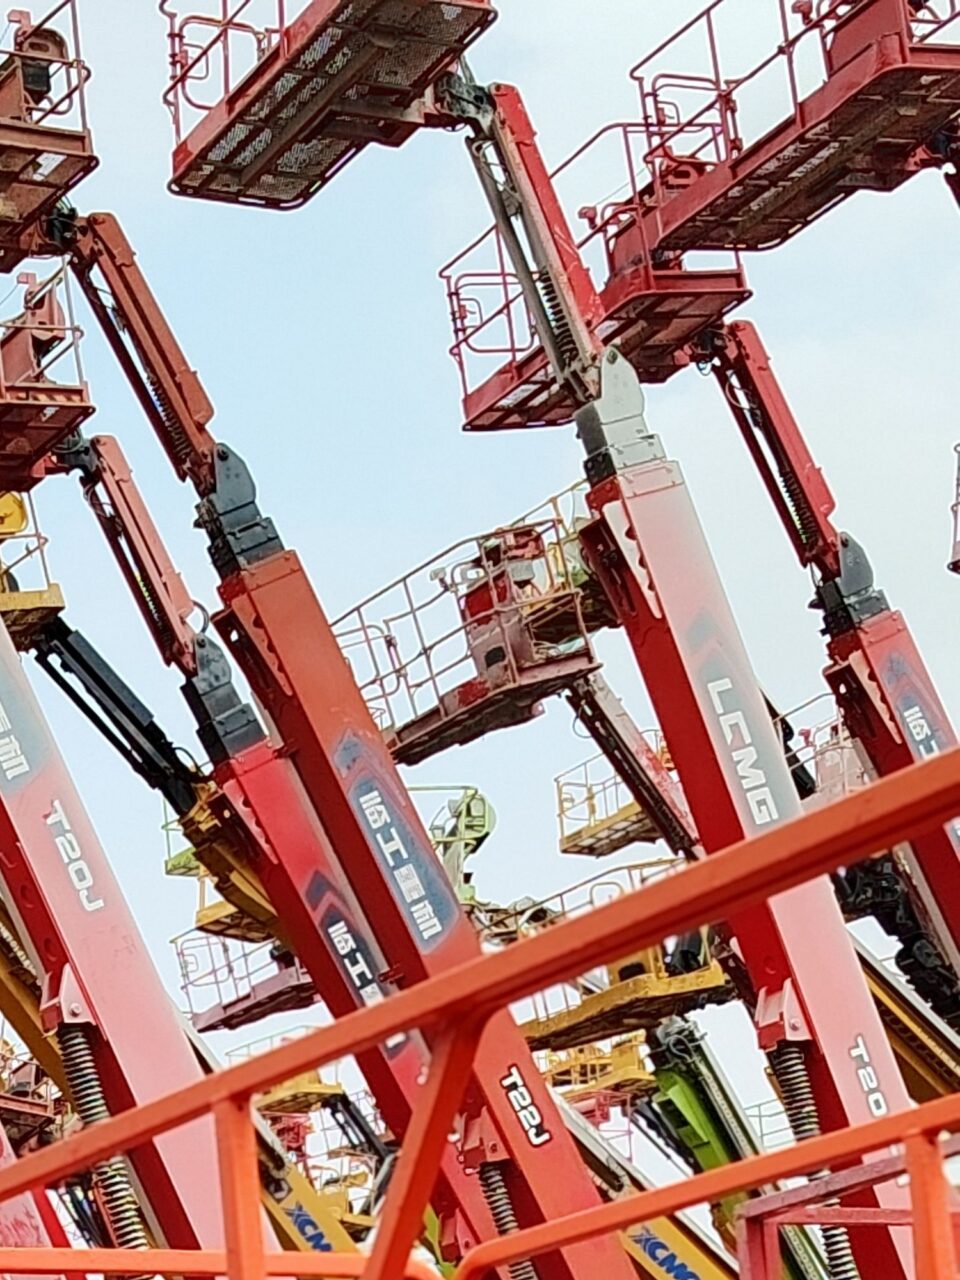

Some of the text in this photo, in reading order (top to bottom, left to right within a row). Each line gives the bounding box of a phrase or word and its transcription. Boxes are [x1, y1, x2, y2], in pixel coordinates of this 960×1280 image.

[46, 800, 104, 912] T20J
[360, 790, 443, 940] 临工重机
[500, 1065, 551, 1145] T22J
[850, 1035, 888, 1117] T20
